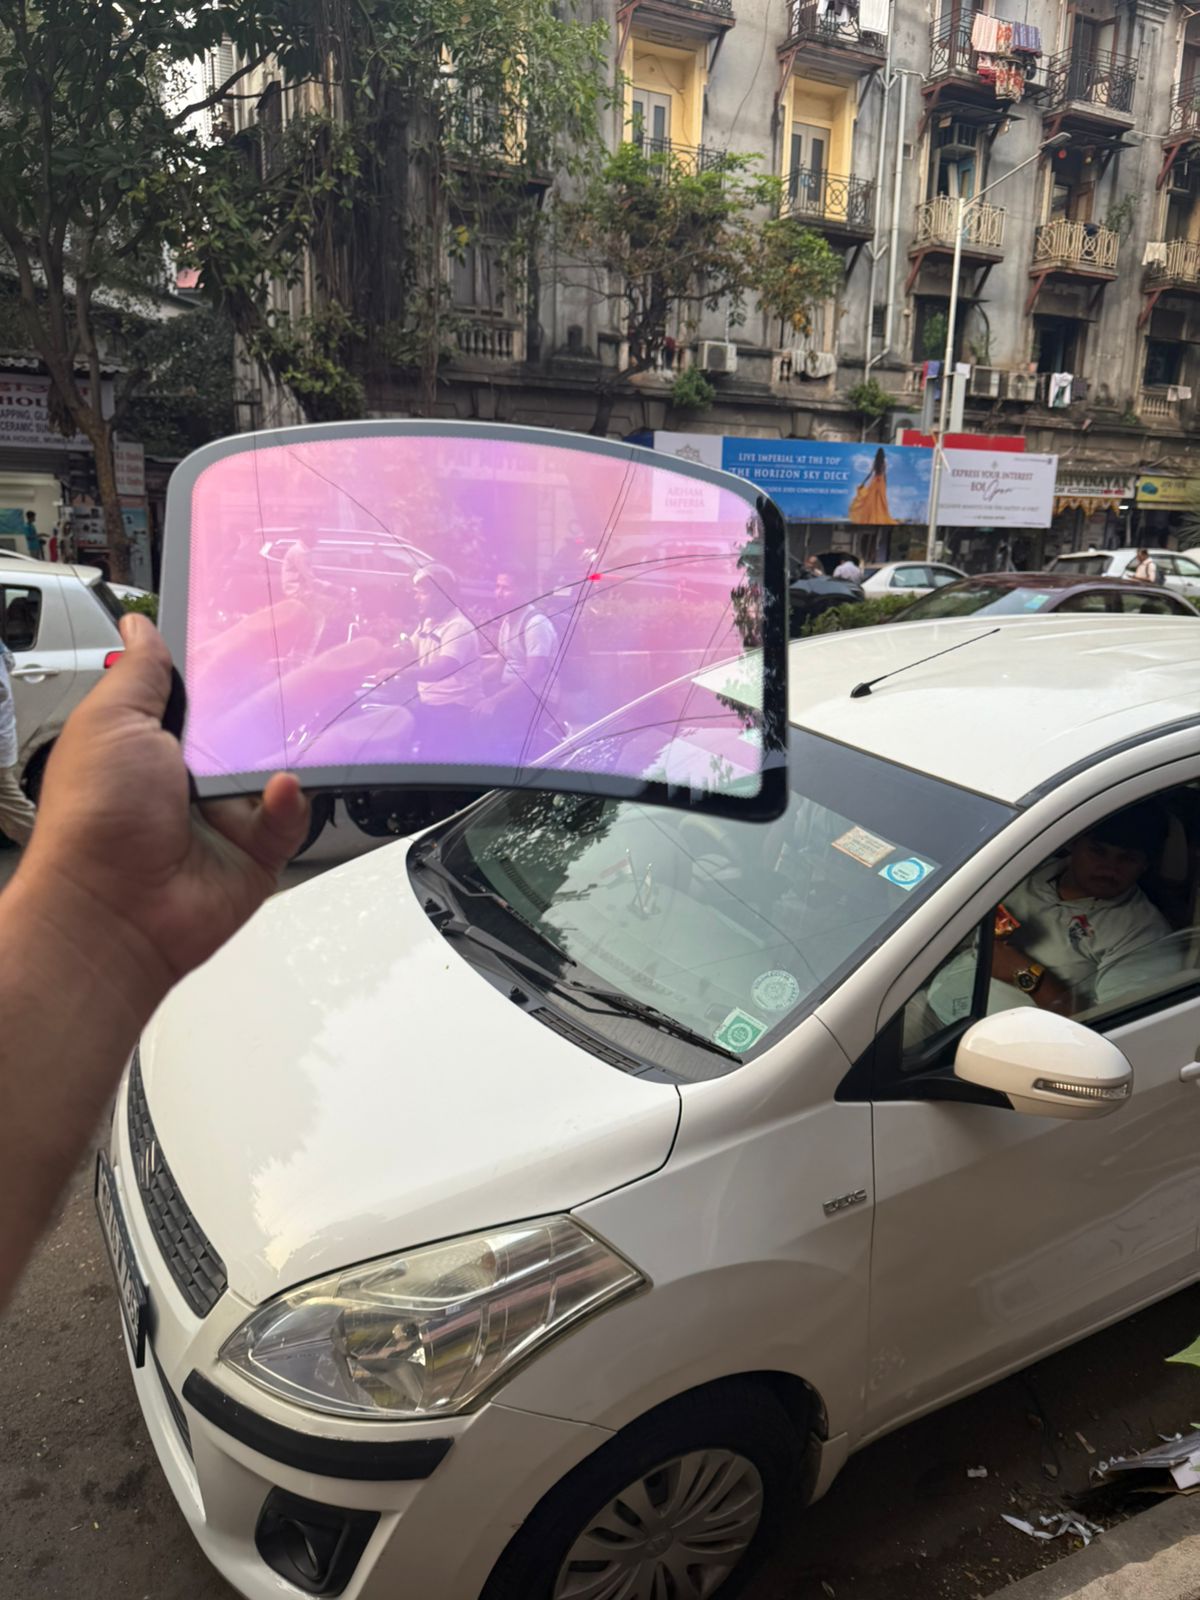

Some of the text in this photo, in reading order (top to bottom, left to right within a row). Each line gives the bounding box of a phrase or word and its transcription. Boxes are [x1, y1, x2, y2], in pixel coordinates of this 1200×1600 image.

[739, 453, 756, 462] LIVE
[758, 454, 793, 463] IMPERIAL
[808, 456, 823, 464] THE
[754, 468, 801, 479] HORIZON
[803, 471, 822, 480] SKY
[951, 468, 1034, 481] EXPRESS YOUR INTEREST
